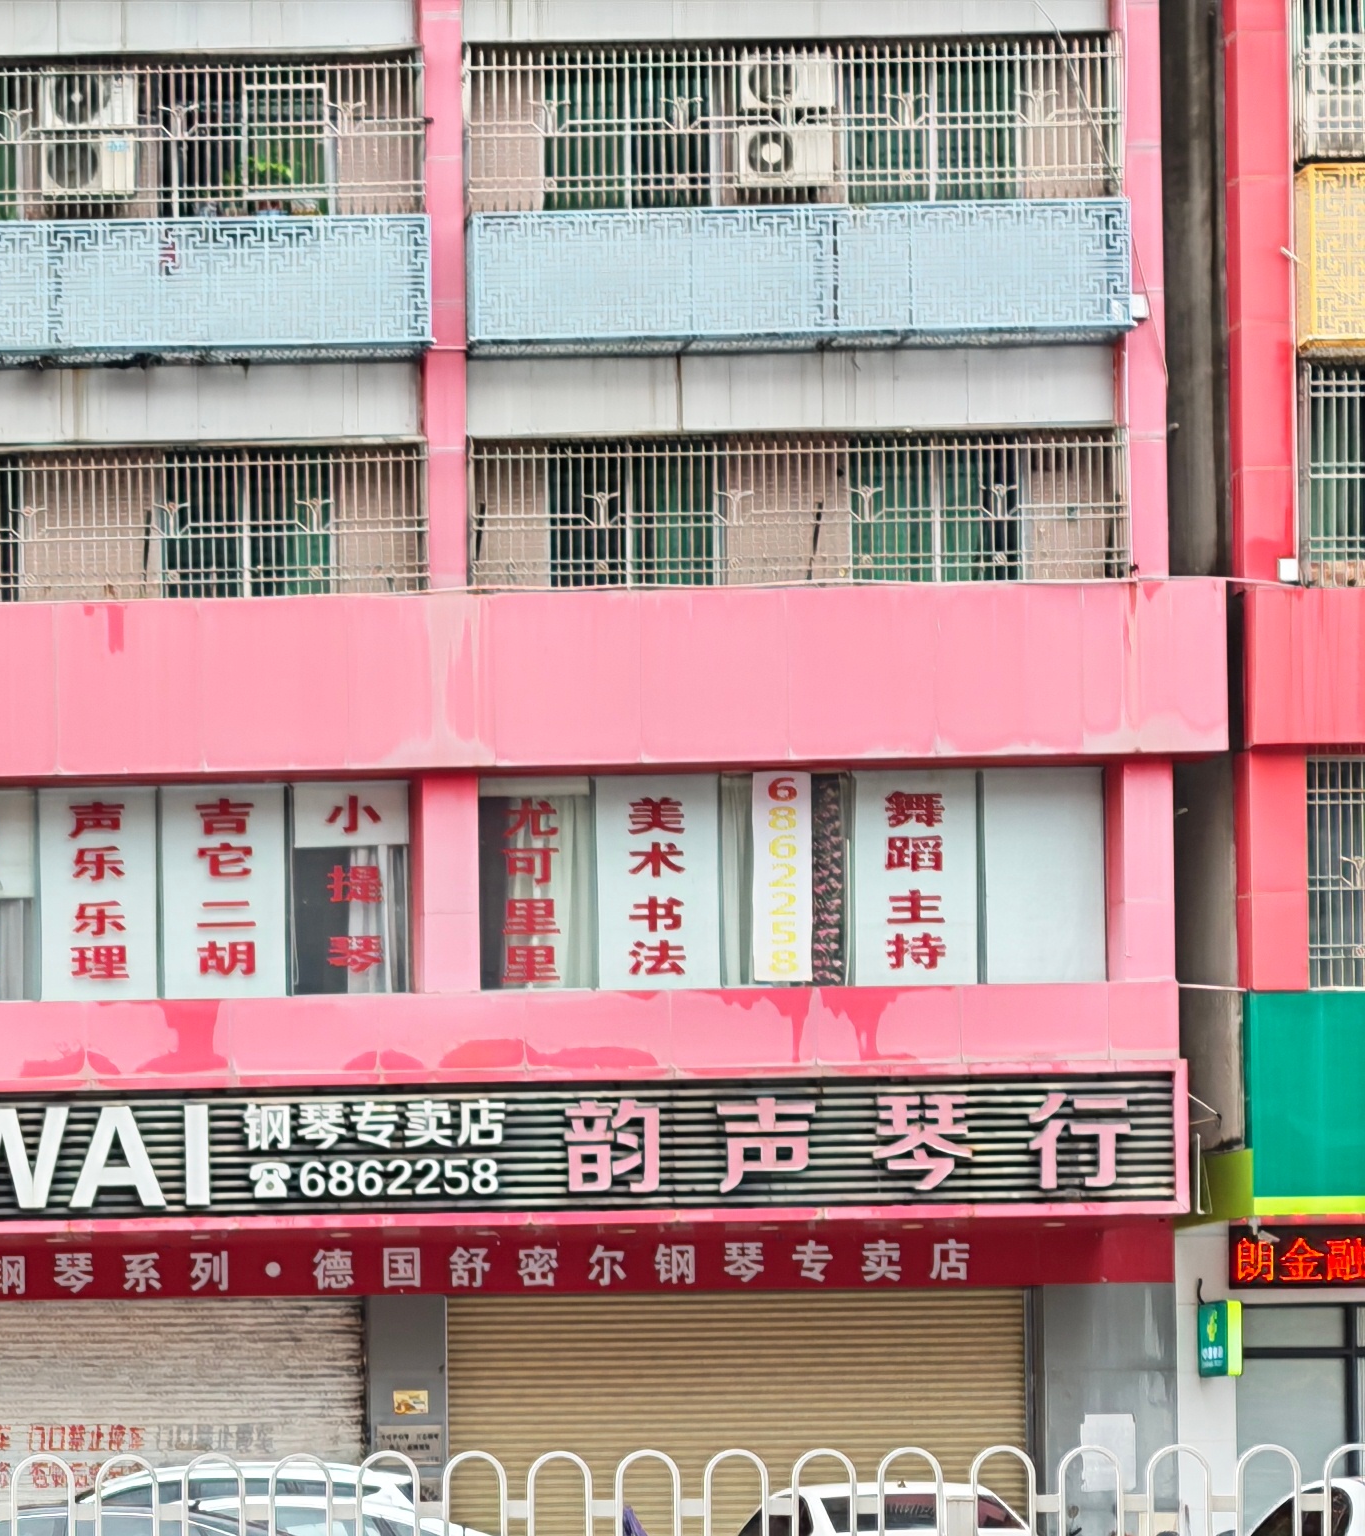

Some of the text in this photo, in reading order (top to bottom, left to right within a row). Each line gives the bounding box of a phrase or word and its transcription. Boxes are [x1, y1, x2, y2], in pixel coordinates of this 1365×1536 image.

[69, 801, 130, 981] 声乐乐理
[195, 798, 258, 976] 吉它二胡
[327, 794, 384, 972] 小提琴
[627, 796, 686, 976] 美术书法
[768, 777, 798, 974] 6862258
[884, 790, 946, 970] 舞蹈主持
[243, 1098, 507, 1150] 钢琴专卖店
[298, 1157, 501, 1199] 6862258
[563, 1090, 1132, 1194] 韵声琴行
[29, 1424, 146, 1451] 门口禁止停车
